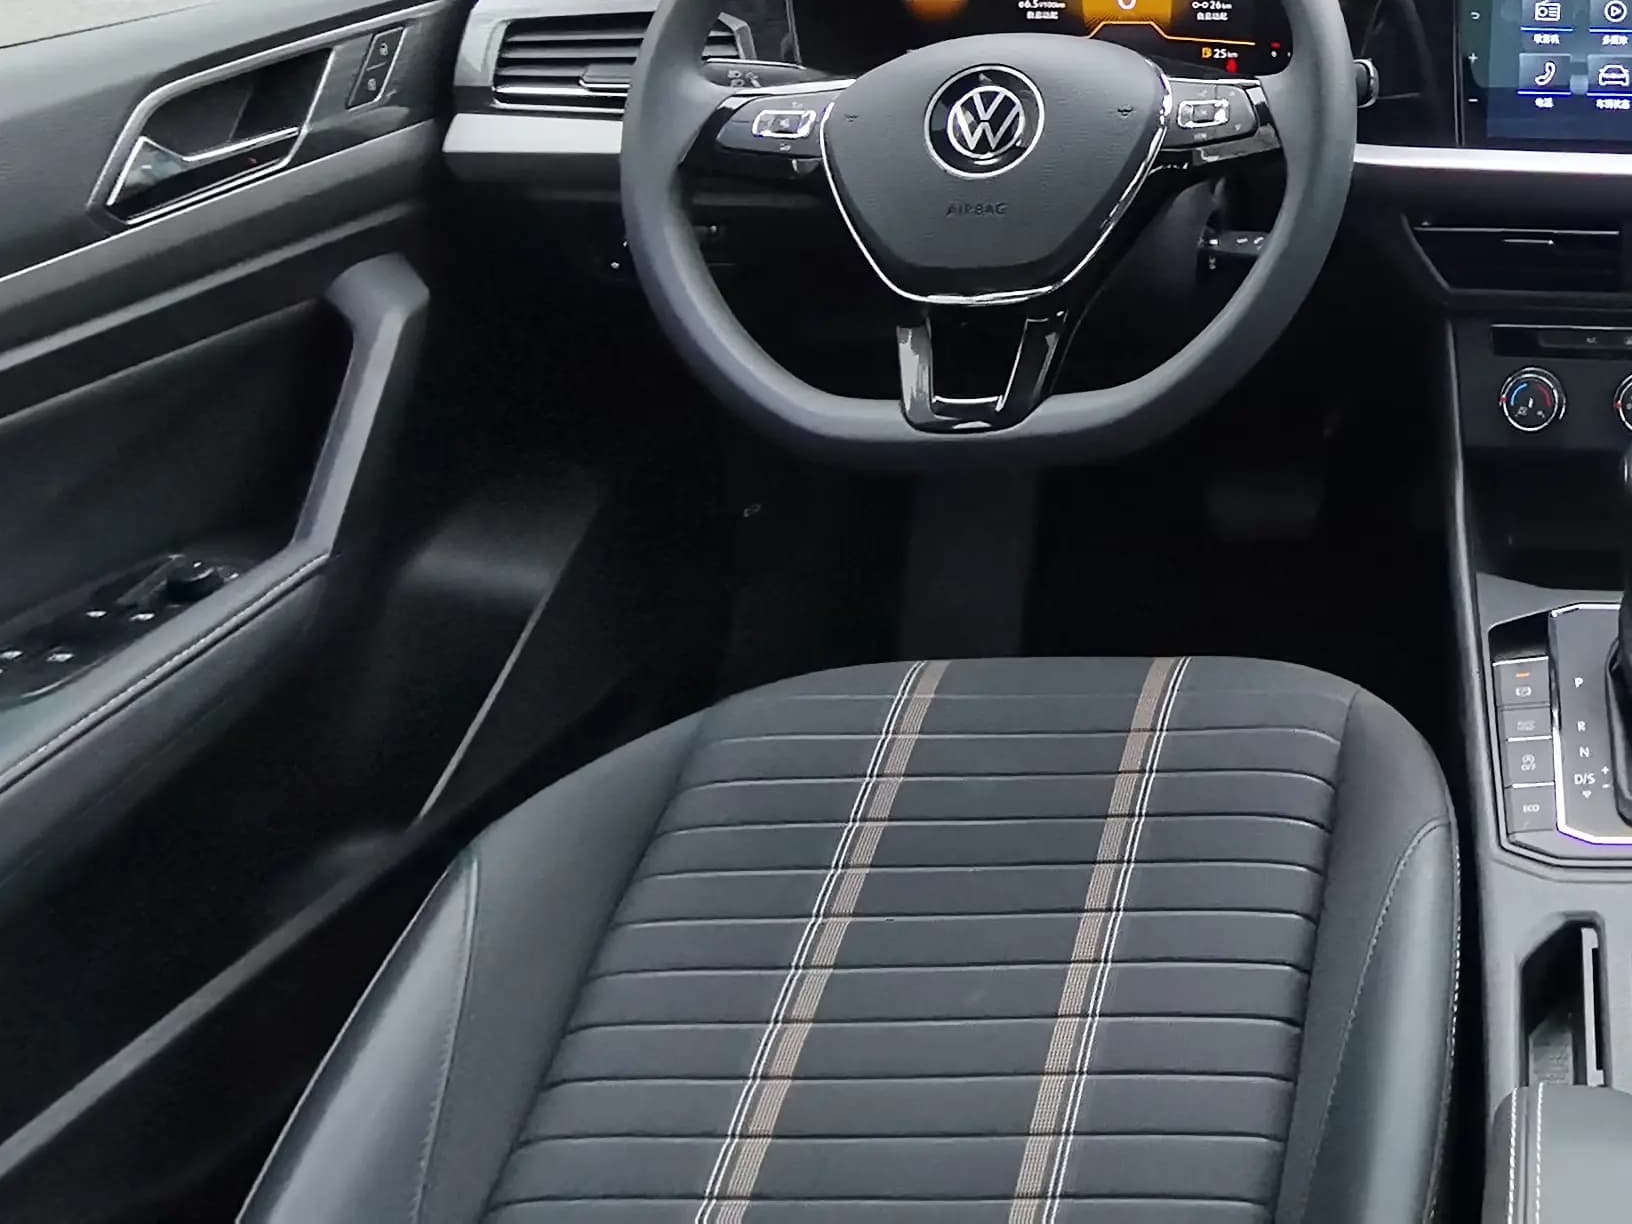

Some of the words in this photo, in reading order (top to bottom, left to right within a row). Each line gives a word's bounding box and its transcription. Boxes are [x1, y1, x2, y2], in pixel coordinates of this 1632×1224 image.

[1213, 49, 1227, 59] 25
[1574, 677, 1584, 688] P
[1577, 721, 1586, 732] R
[1579, 747, 1590, 758] N
[1574, 773, 1596, 785] D/S
